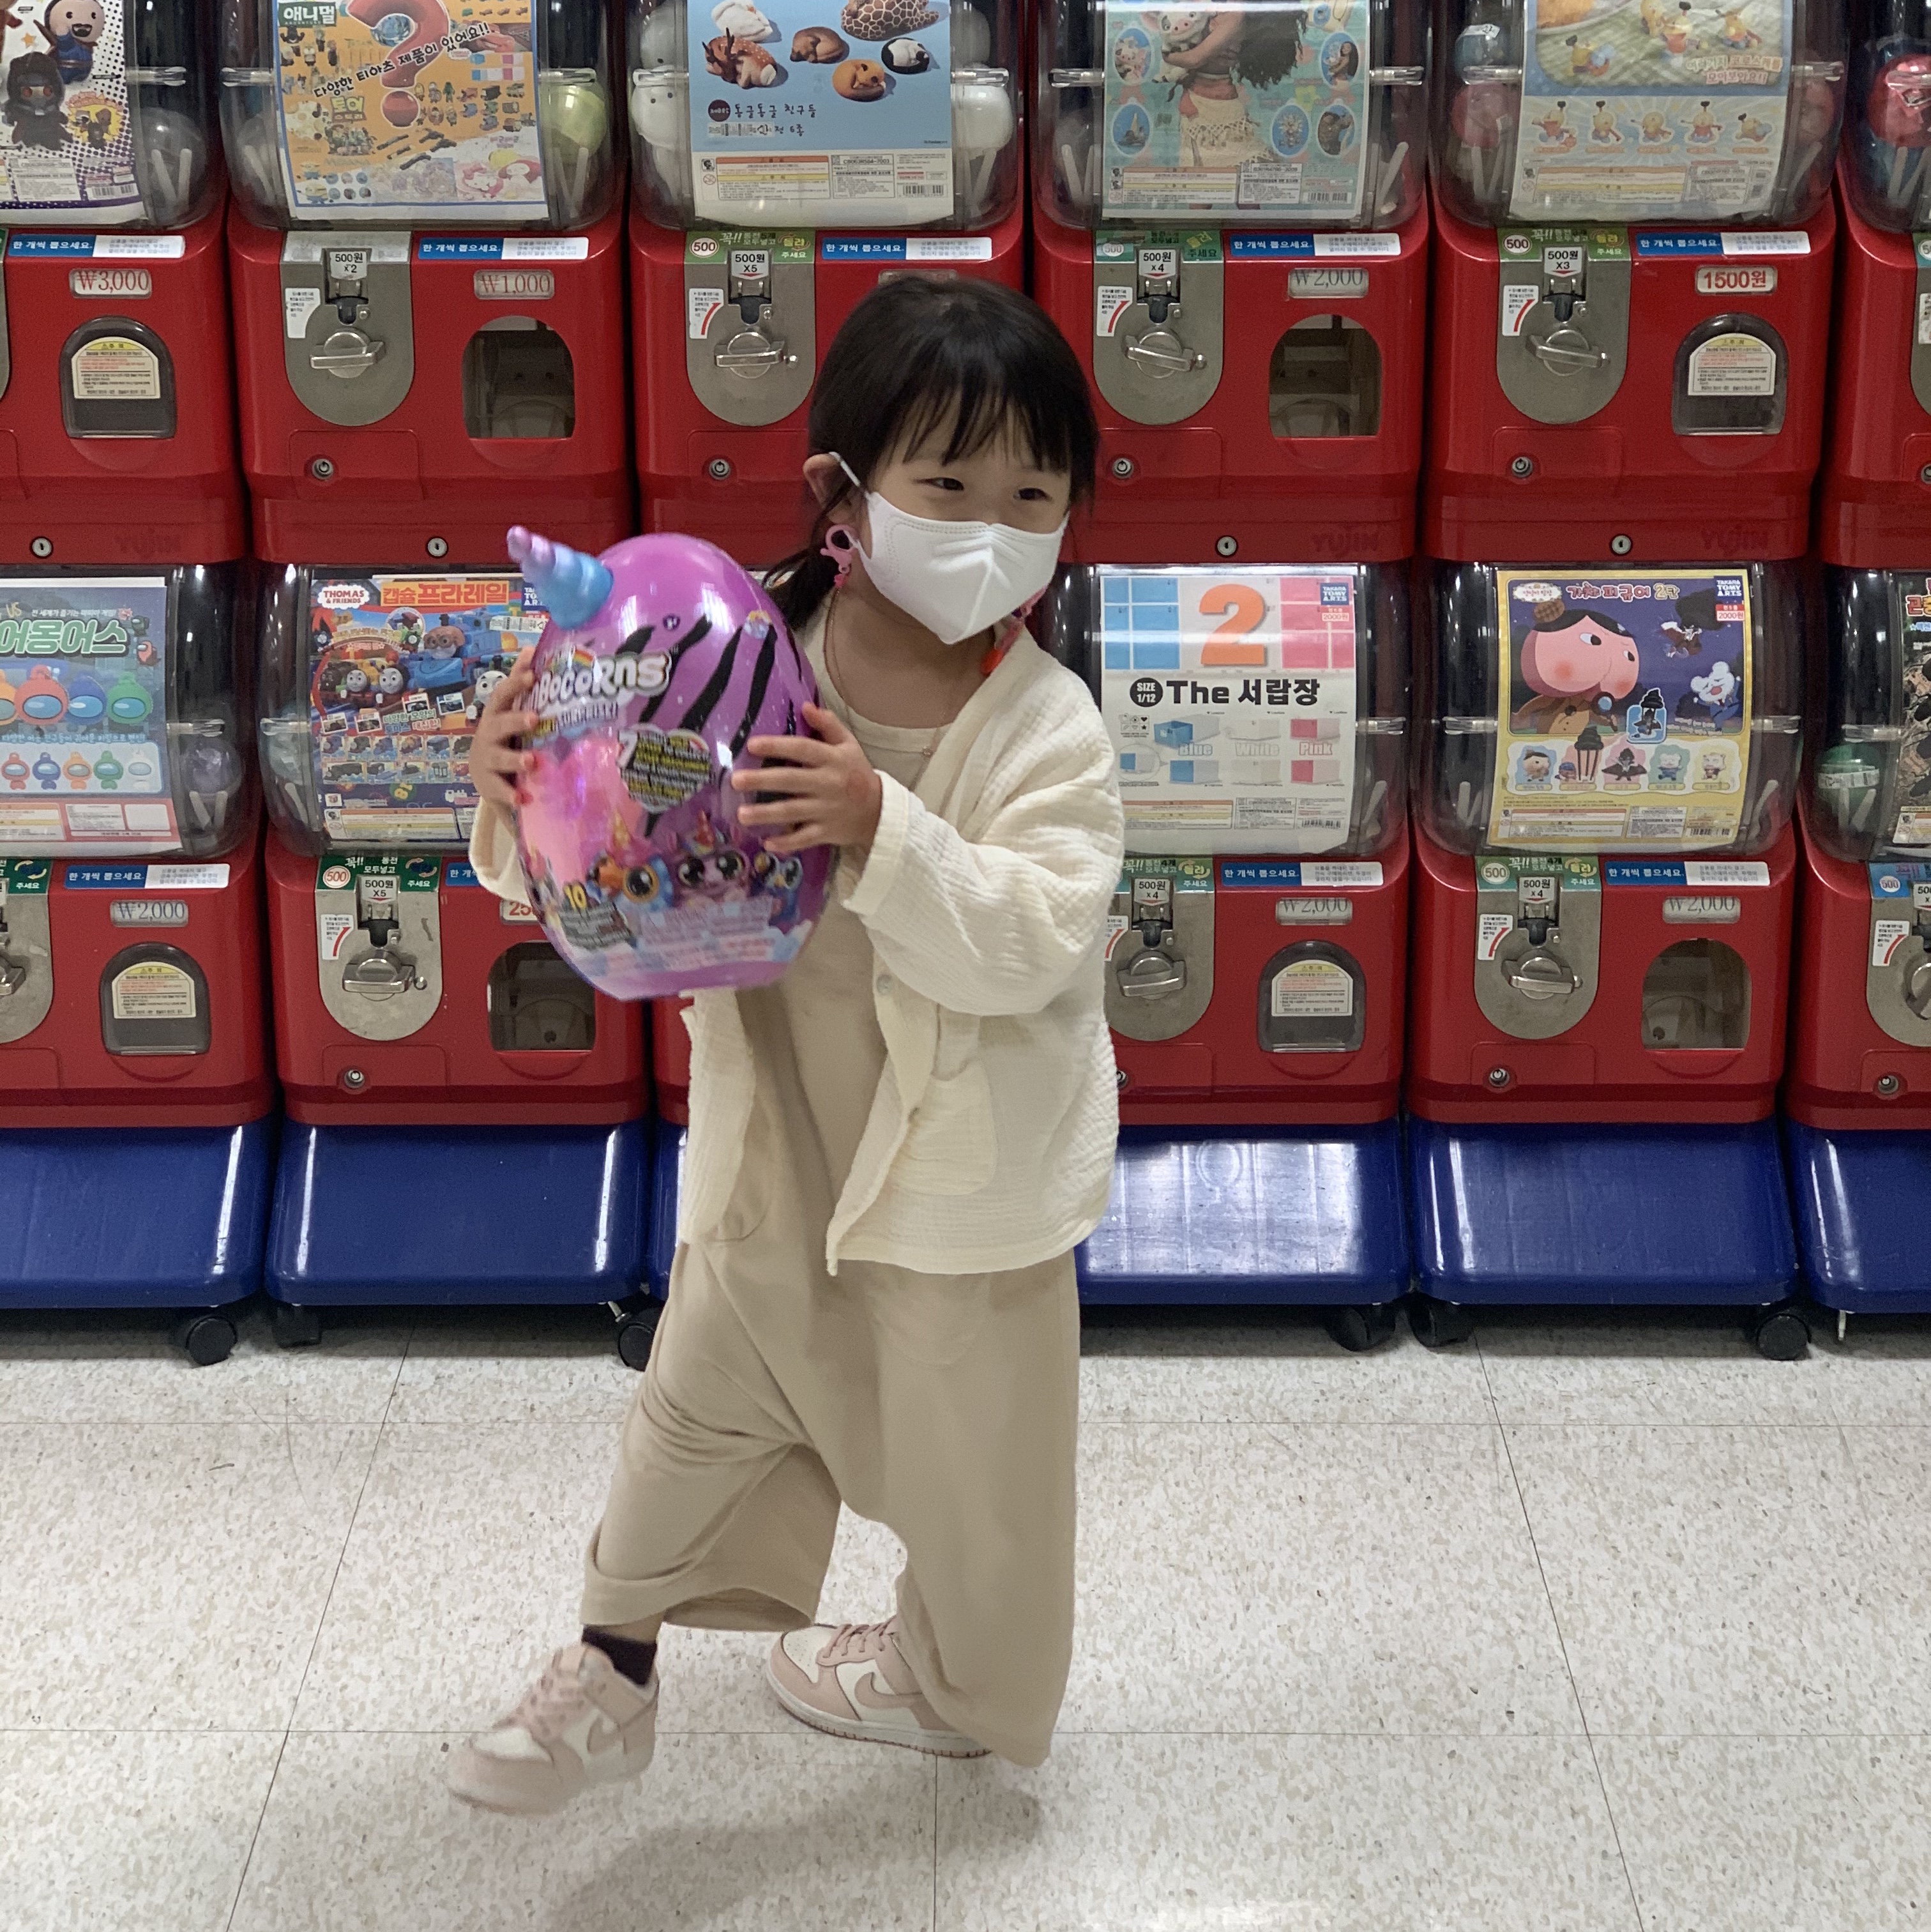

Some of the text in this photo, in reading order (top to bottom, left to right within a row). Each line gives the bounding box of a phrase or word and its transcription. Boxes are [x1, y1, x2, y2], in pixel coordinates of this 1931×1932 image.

[314, 22, 490, 98] 다양한 티아츠 제품이 있어요!!
[735, 103, 777, 118] 동글동글
[785, 104, 816, 118] 친구들
[693, 243, 716, 251] 500
[1640, 239, 1649, 247] 한
[335, 252, 363, 262] 500원
[735, 254, 765, 263] 500원
[1143, 252, 1172, 262] 500원
[1188, 249, 1216, 257] 주세요
[1548, 250, 1579, 261] 500원
[77, 270, 149, 293] ₩3,000
[480, 275, 550, 294] ₩1,000
[1703, 270, 1768, 289] 1500원
[1653, 582, 1680, 600] 2탄
[1199, 584, 1265, 666] 2
[0, 619, 128, 655] 어몽어스
[1137, 683, 1155, 692] SIZE
[1166, 678, 1320, 706] The 서랍장
[1137, 694, 1156, 703] 1/12
[1179, 742, 1333, 756] Blue White Pink
[345, 857, 364, 869] 꼭!!
[327, 871, 347, 882] 500
[1485, 867, 1506, 877] 500
[365, 879, 393, 888] 500원
[1139, 881, 1166, 890] 500원
[1523, 879, 1550, 888] 500원
[1881, 880, 1899, 888] 500
[117, 902, 185, 922] ₩2,000
